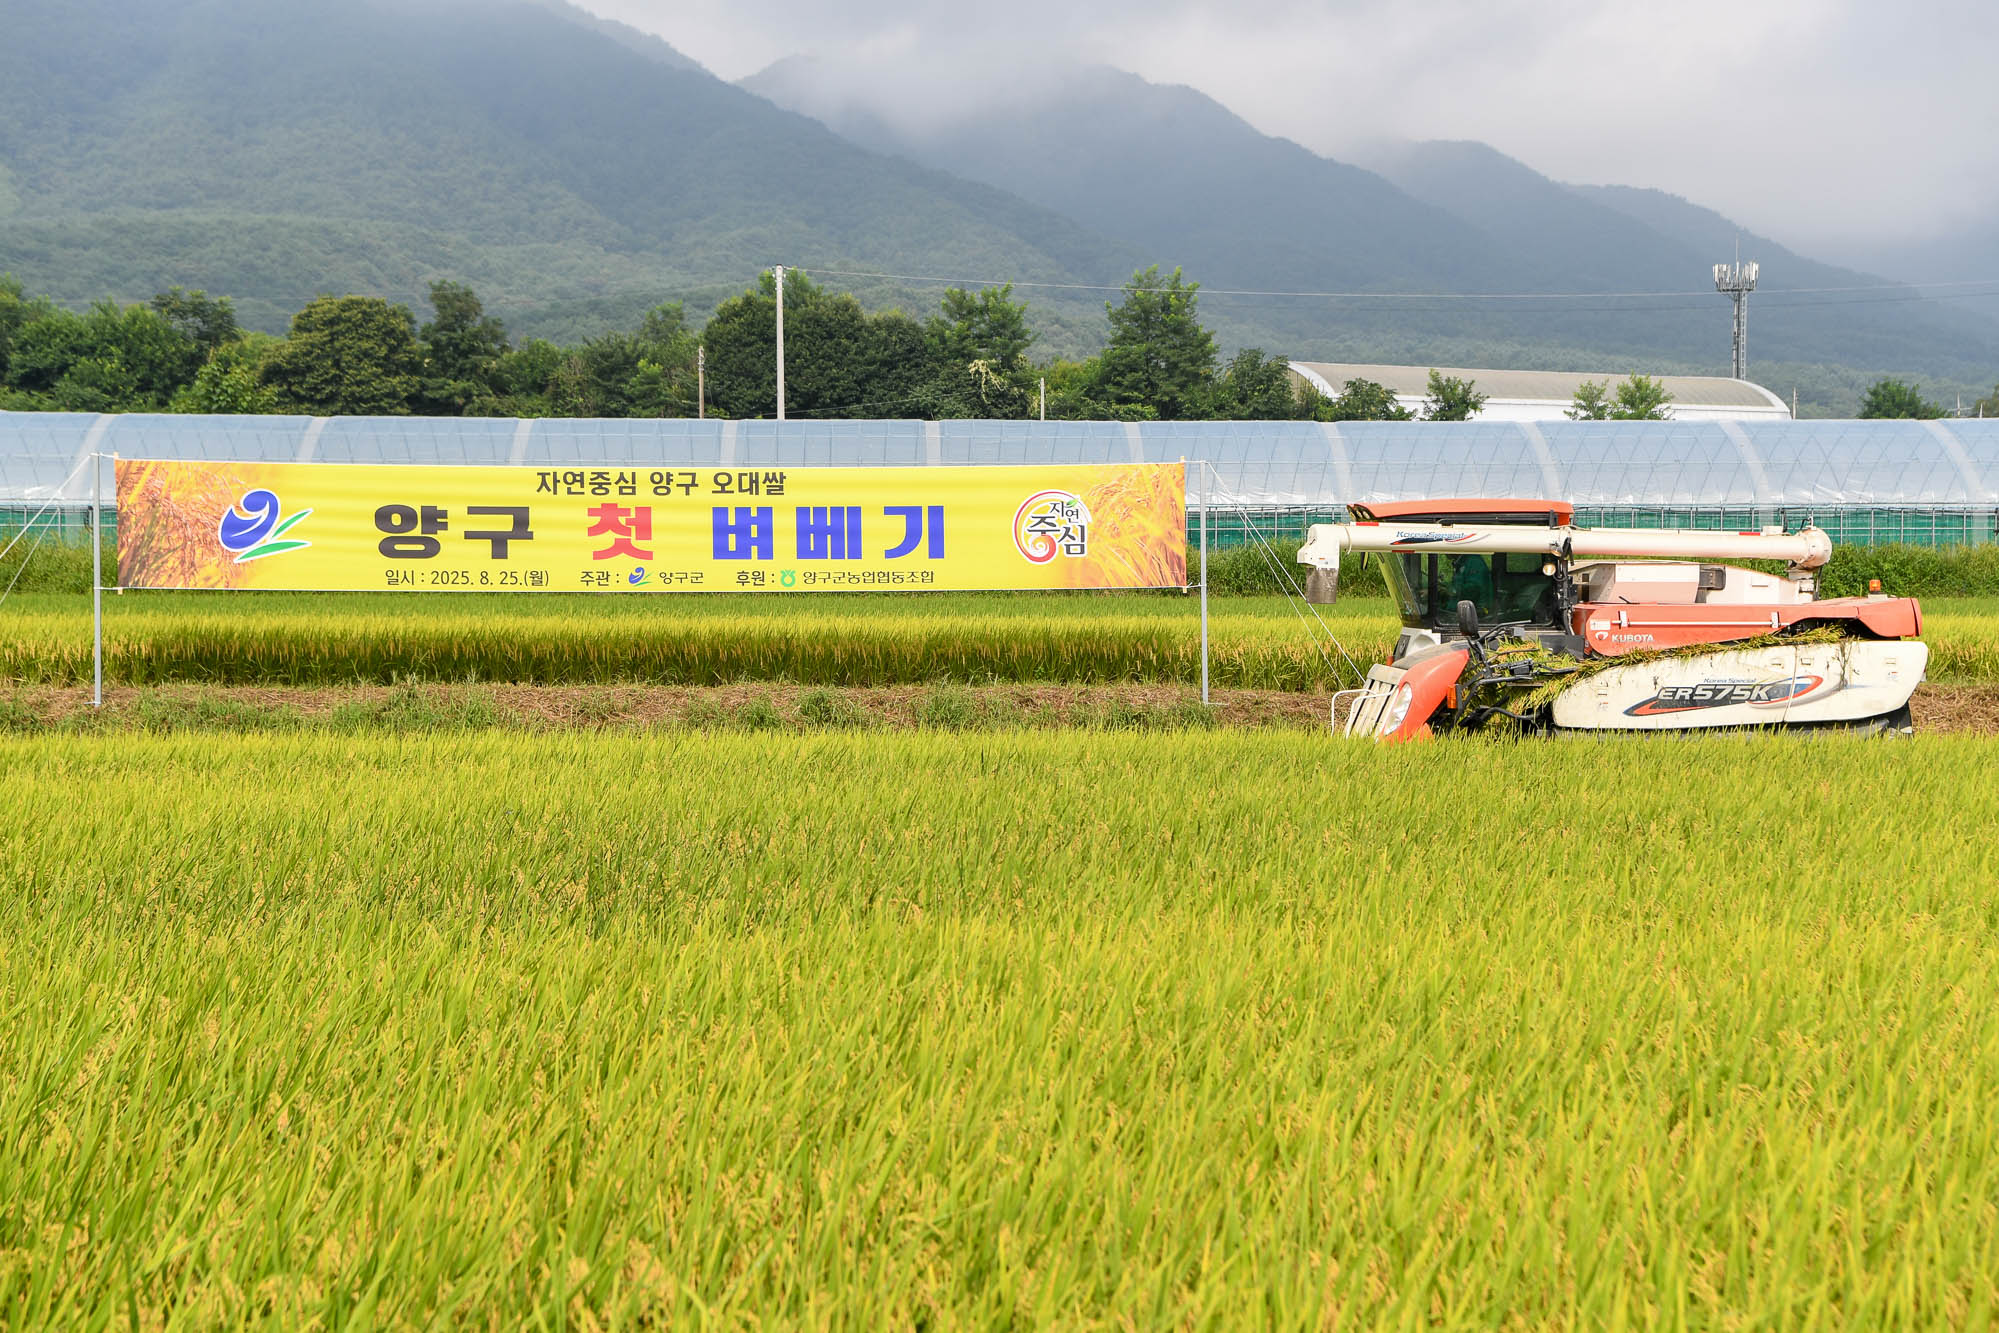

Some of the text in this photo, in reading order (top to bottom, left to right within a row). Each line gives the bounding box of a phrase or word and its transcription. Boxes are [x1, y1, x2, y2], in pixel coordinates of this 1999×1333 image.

[536, 471, 787, 496] 자연중심 양구 오대쌀
[374, 504, 534, 560] 양구
[587, 502, 654, 561] 첫
[1027, 515, 1085, 562] 중심
[385, 569, 415, 586] 일시
[430, 570, 474, 586] 2025.
[479, 570, 494, 586] 8.
[580, 570, 611, 587] 주관
[659, 571, 704, 585] 양구군
[735, 570, 765, 587] 후원
[803, 570, 934, 585] 양구군농업협동조합
[1611, 634, 1654, 643] KUBOTA
[1657, 685, 1772, 701] ER575K
